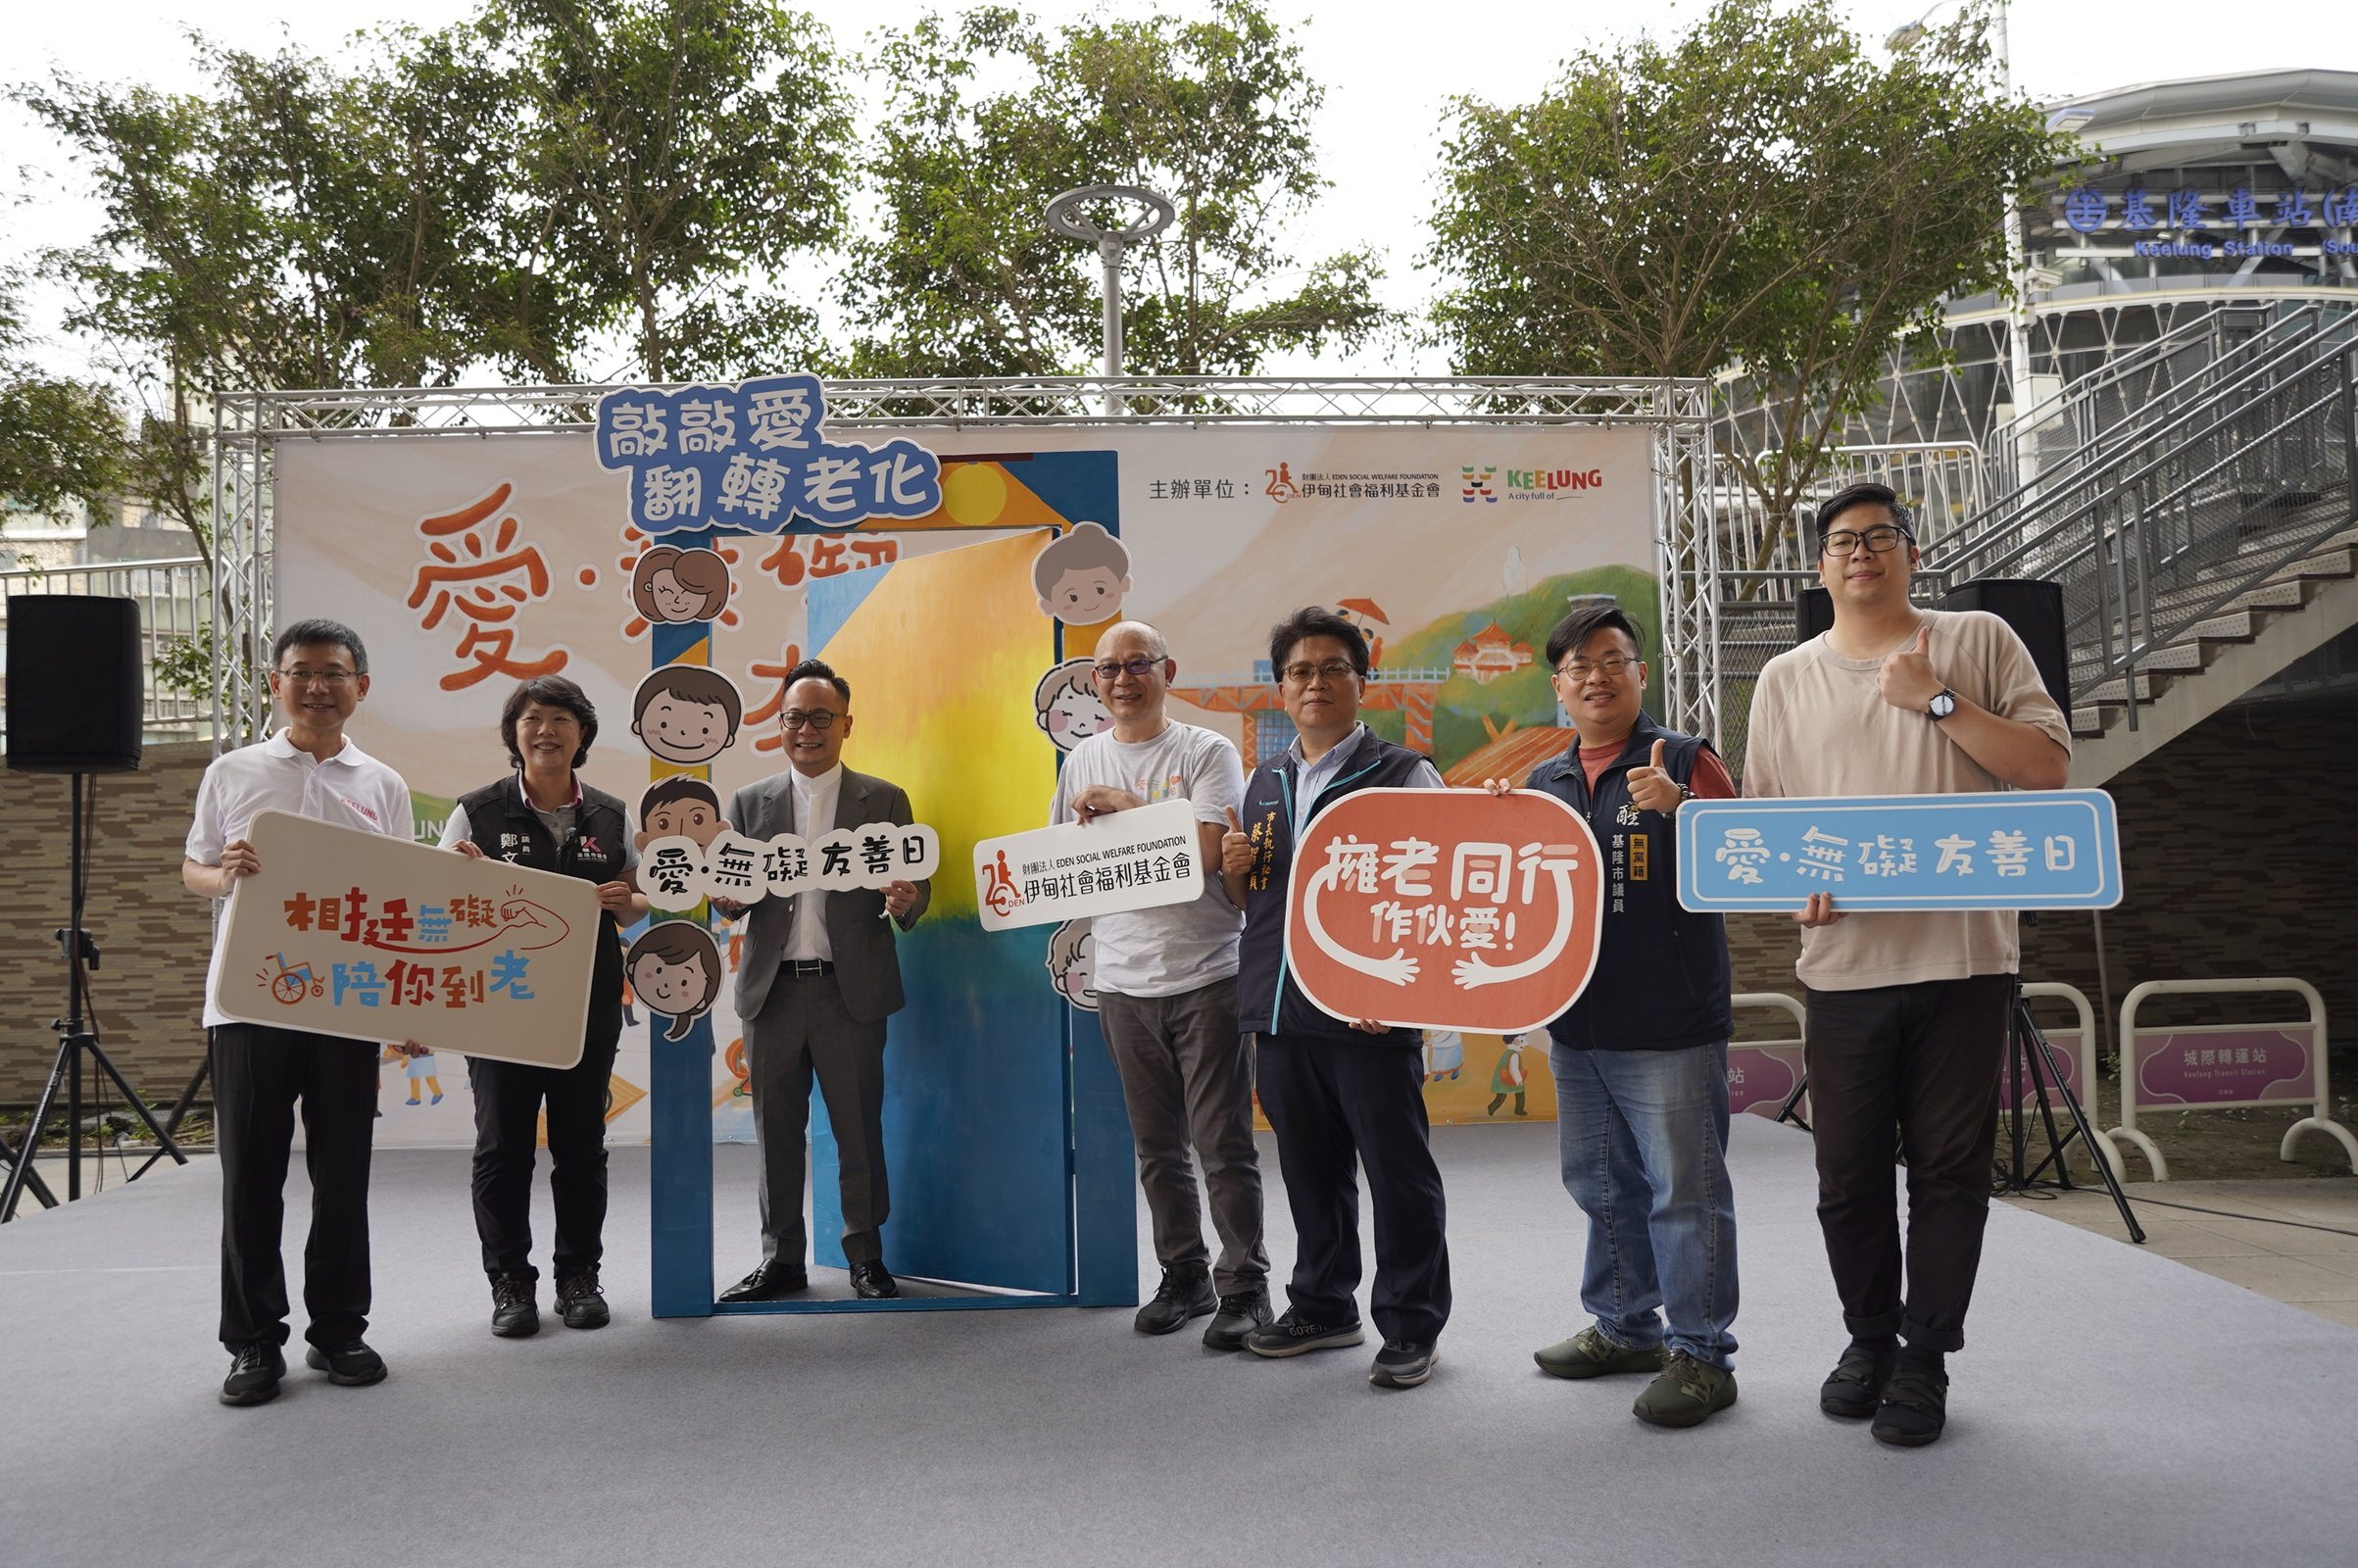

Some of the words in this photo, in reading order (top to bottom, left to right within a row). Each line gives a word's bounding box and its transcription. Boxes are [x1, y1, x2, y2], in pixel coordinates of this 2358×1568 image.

[2134, 241, 2212, 260] Keelung
[2224, 240, 2294, 257] Station
[610, 387, 812, 458] 敲敲愛
[643, 452, 927, 522] 翻轉老化
[1149, 478, 1251, 500] 主辦單位：
[1302, 483, 1441, 499] 伊甸社會福利基金會
[1507, 469, 1602, 490] KEELUNG
[1515, 492, 1530, 501] city
[1022, 859, 1056, 875] 財團法人
[1056, 857, 1074, 868] EDEN
[1076, 852, 1101, 864] SOCIAL
[1103, 845, 1135, 860] WELFARE
[1137, 835, 1187, 854] FOUNDATION
[1324, 835, 1579, 905] 擁老同行
[1633, 838, 1645, 877] 無黨籍
[1024, 852, 1191, 904] 伊甸社會福利基金會
[1612, 834, 1625, 913] 基隆市議員
[283, 887, 498, 947] 相挺無礙
[1370, 900, 1515, 950] 作伙愛!
[332, 950, 535, 1008] 陪你到老
[2184, 1047, 2267, 1066] 城際轉運站
